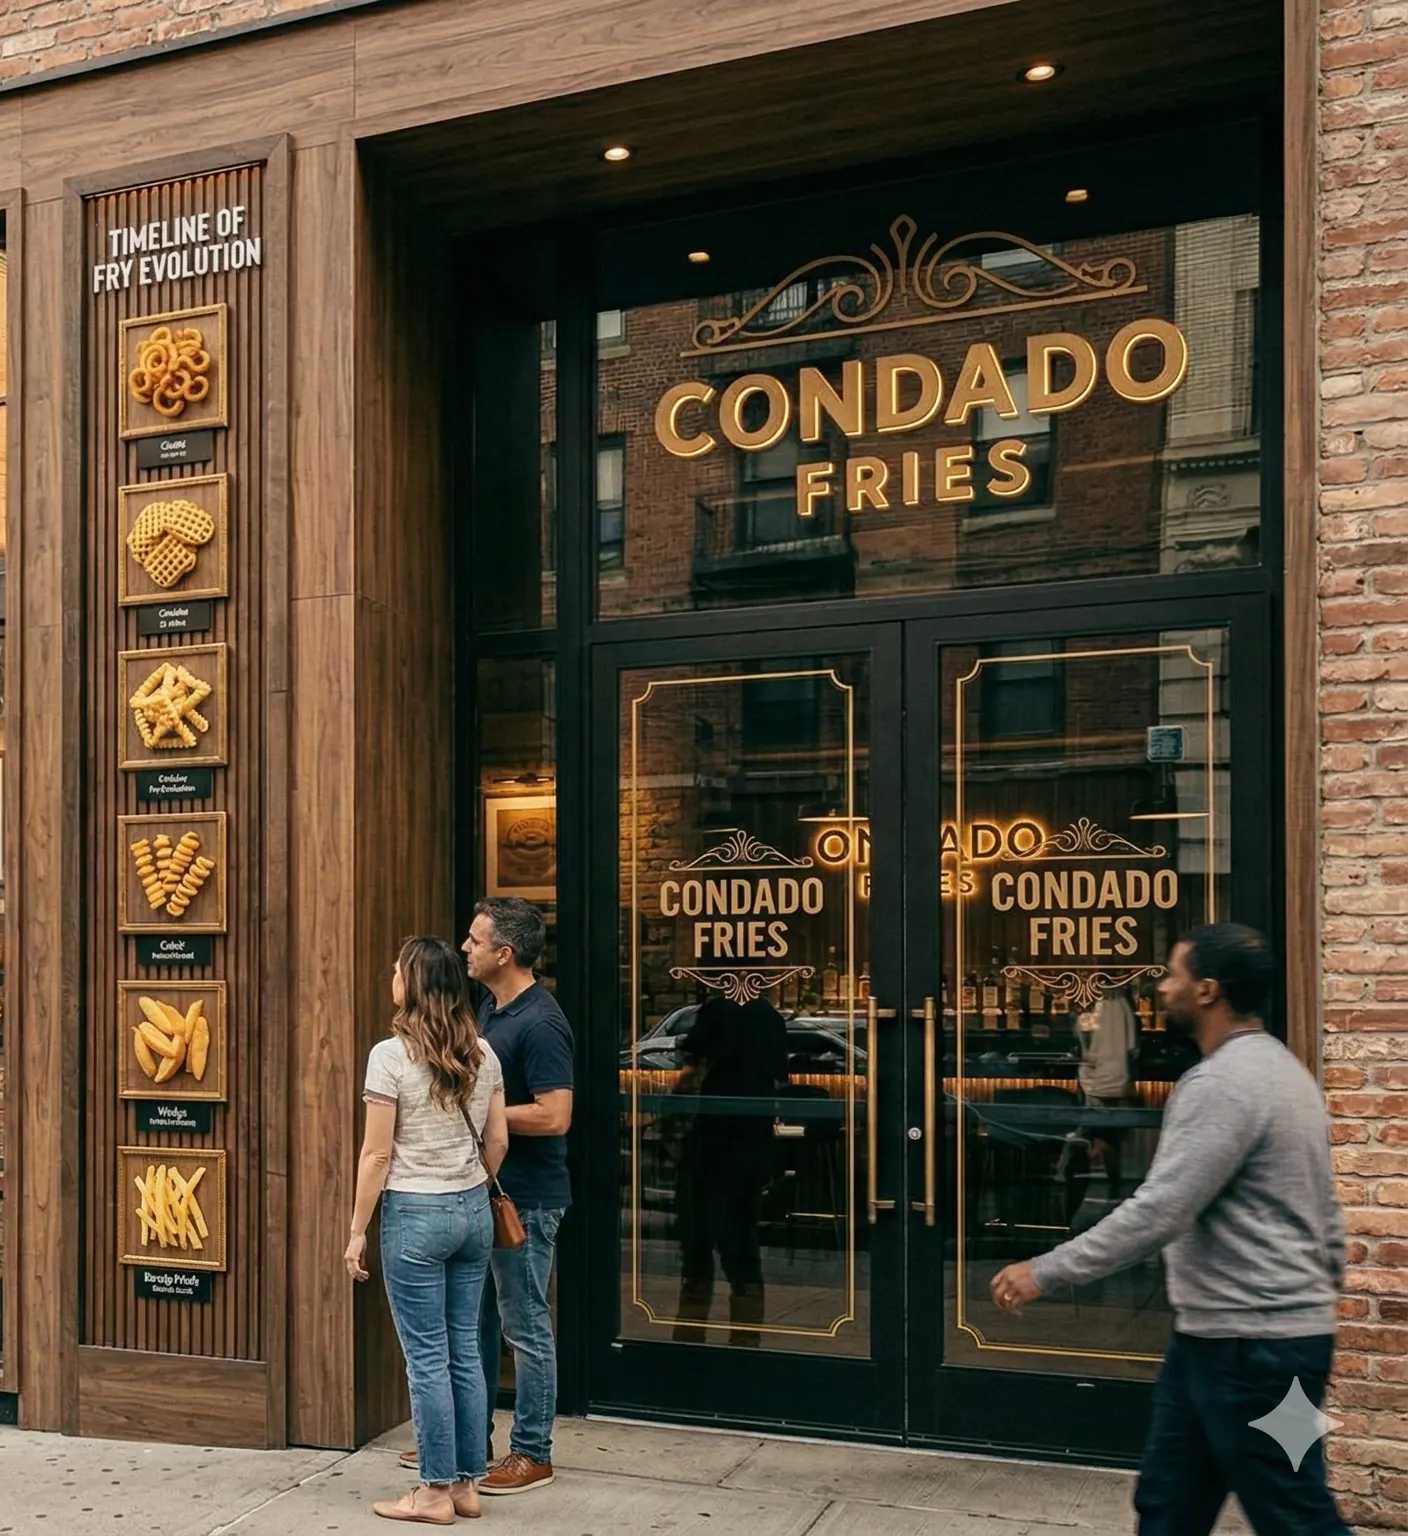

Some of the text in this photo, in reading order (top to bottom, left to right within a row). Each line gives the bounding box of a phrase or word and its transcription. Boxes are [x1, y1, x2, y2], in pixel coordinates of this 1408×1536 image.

[109, 206, 245, 257] TIMELINE OF
[94, 237, 261, 293] FRY EVOLUTION
[654, 318, 1189, 458] CONDADO
[797, 440, 1030, 517] FRIES
[660, 878, 824, 916] CONDADO
[992, 869, 1178, 911] CONDADO
[694, 921, 789, 958] FRIES
[1030, 916, 1138, 955] FRIES
